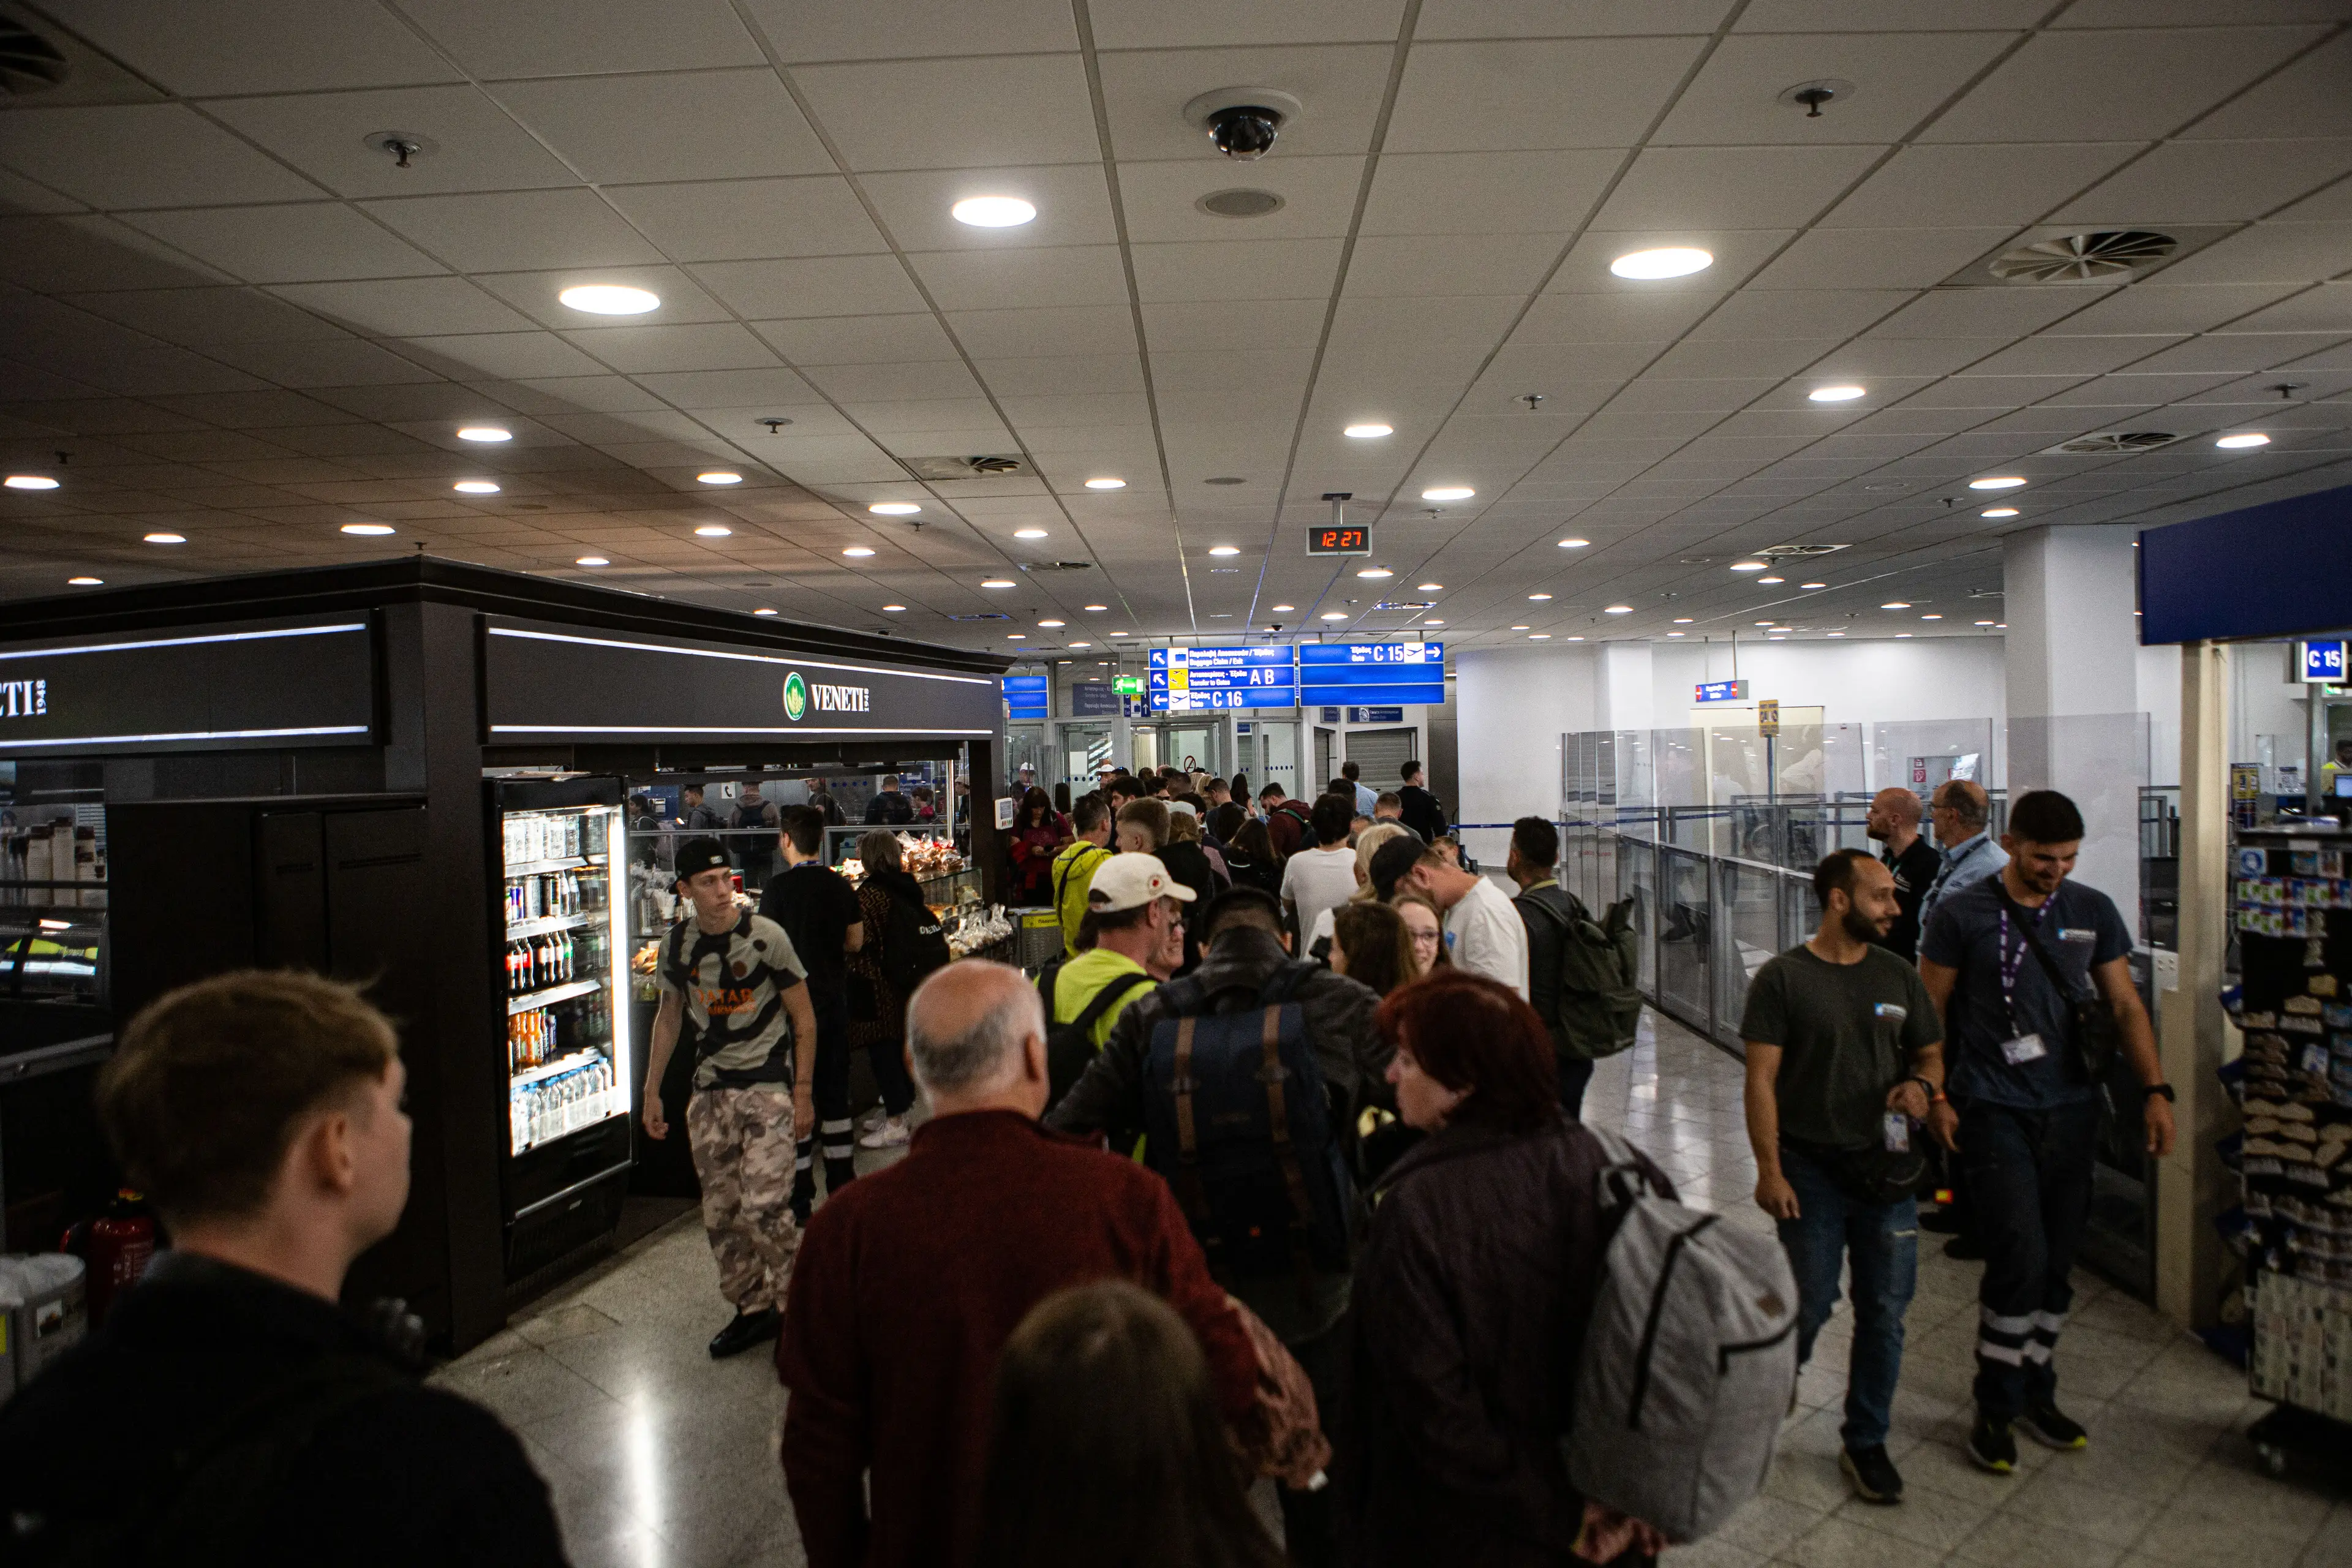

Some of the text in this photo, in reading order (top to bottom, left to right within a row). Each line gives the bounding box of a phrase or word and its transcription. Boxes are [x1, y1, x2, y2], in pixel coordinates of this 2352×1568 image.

[1322, 531, 1362, 547] 12 27
[1373, 646, 1404, 662] C 15
[2308, 650, 2341, 668] C 15
[1250, 668, 1275, 685] A B
[0, 680, 35, 718] TI
[36, 679, 47, 715] 1948
[811, 684, 864, 712] VENETI
[1212, 690, 1243, 707] C 16
